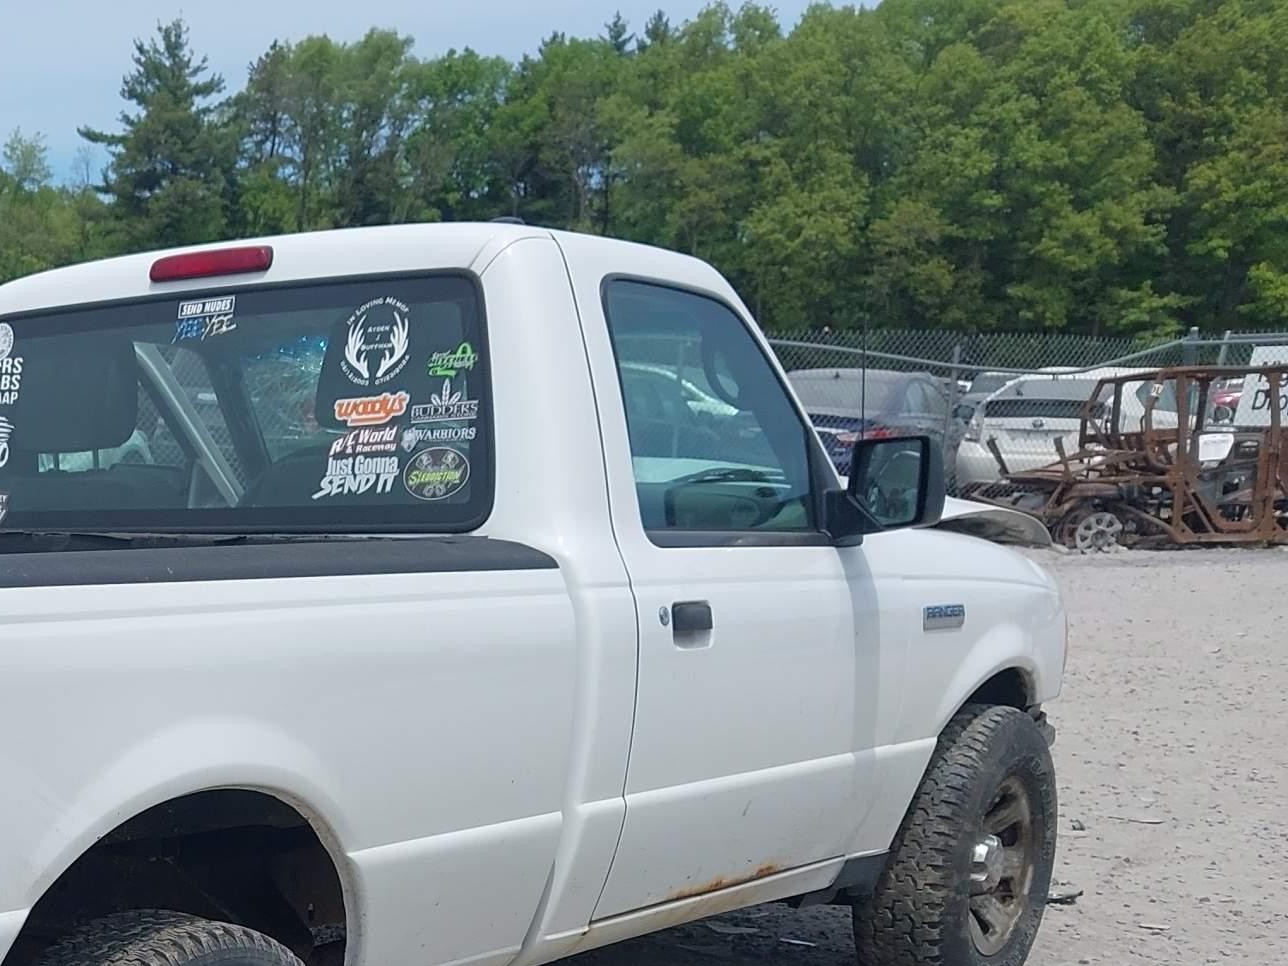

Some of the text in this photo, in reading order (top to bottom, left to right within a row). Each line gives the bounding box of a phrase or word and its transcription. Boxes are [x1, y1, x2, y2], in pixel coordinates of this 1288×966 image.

[182, 299, 232, 316] SEND NUDES
[355, 297, 384, 316] LOVING
[358, 425, 398, 443] World
[415, 427, 477, 441] WARRIORS
[355, 443, 397, 454] Raceway
[326, 455, 400, 476] Just Gonna
[312, 472, 400, 500] SEND IT
